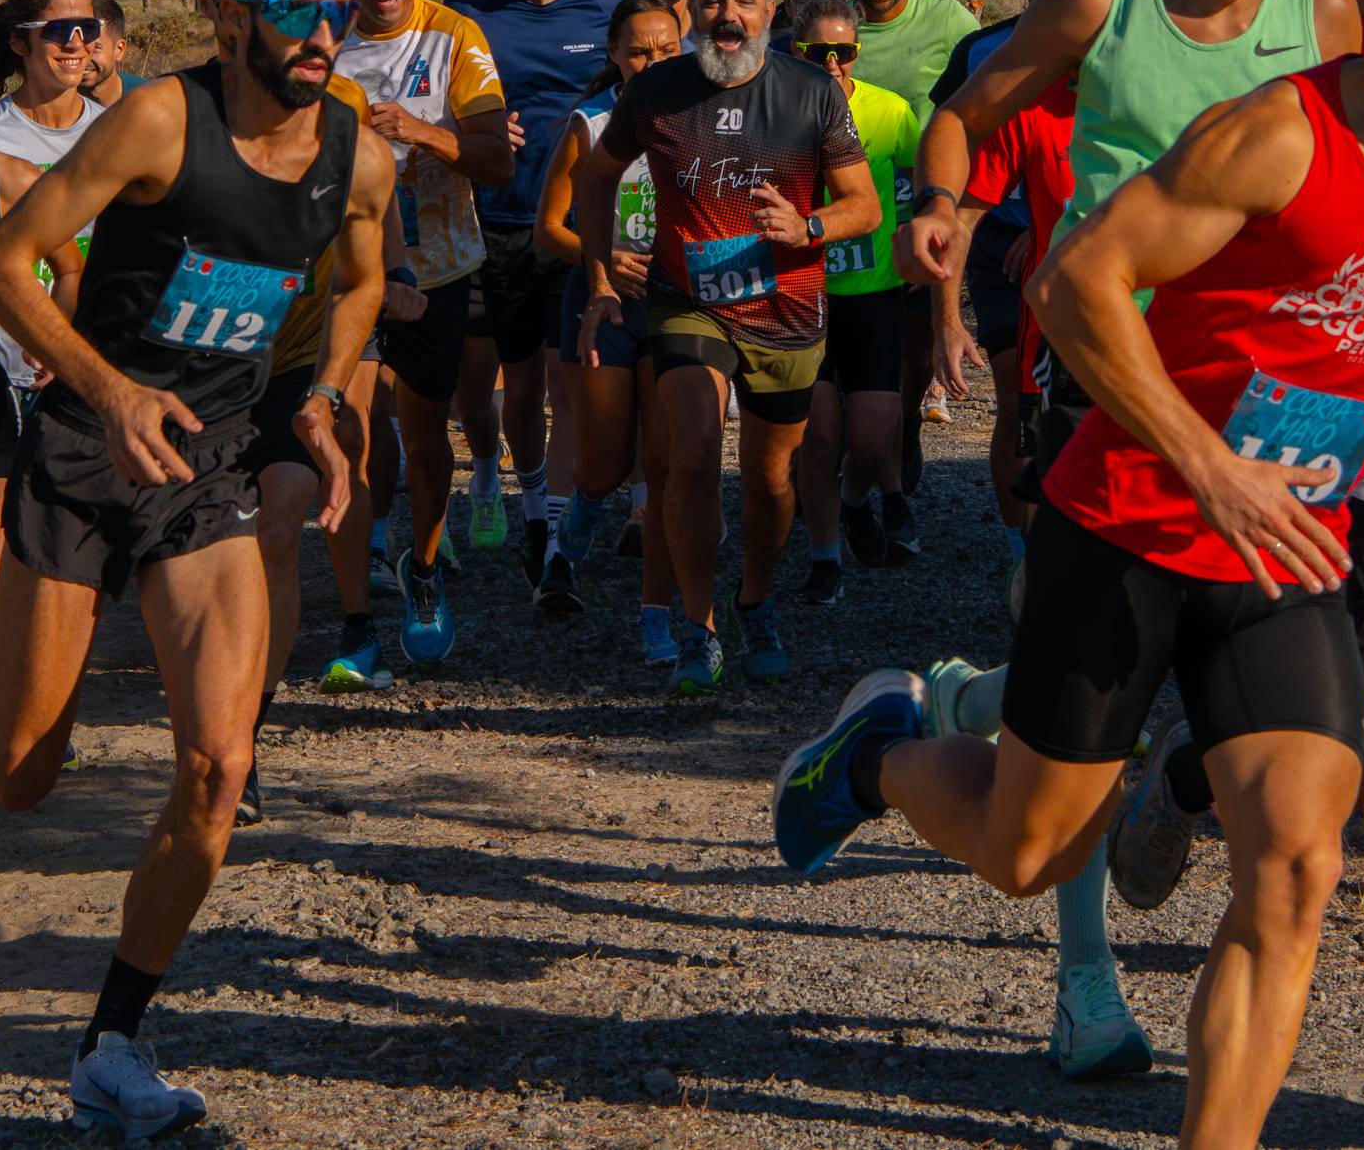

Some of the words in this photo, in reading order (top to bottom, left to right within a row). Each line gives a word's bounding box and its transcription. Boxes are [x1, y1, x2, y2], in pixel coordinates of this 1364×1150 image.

[716, 108, 743, 130] 20
[699, 267, 765, 301] 501
[162, 301, 265, 352] 112
